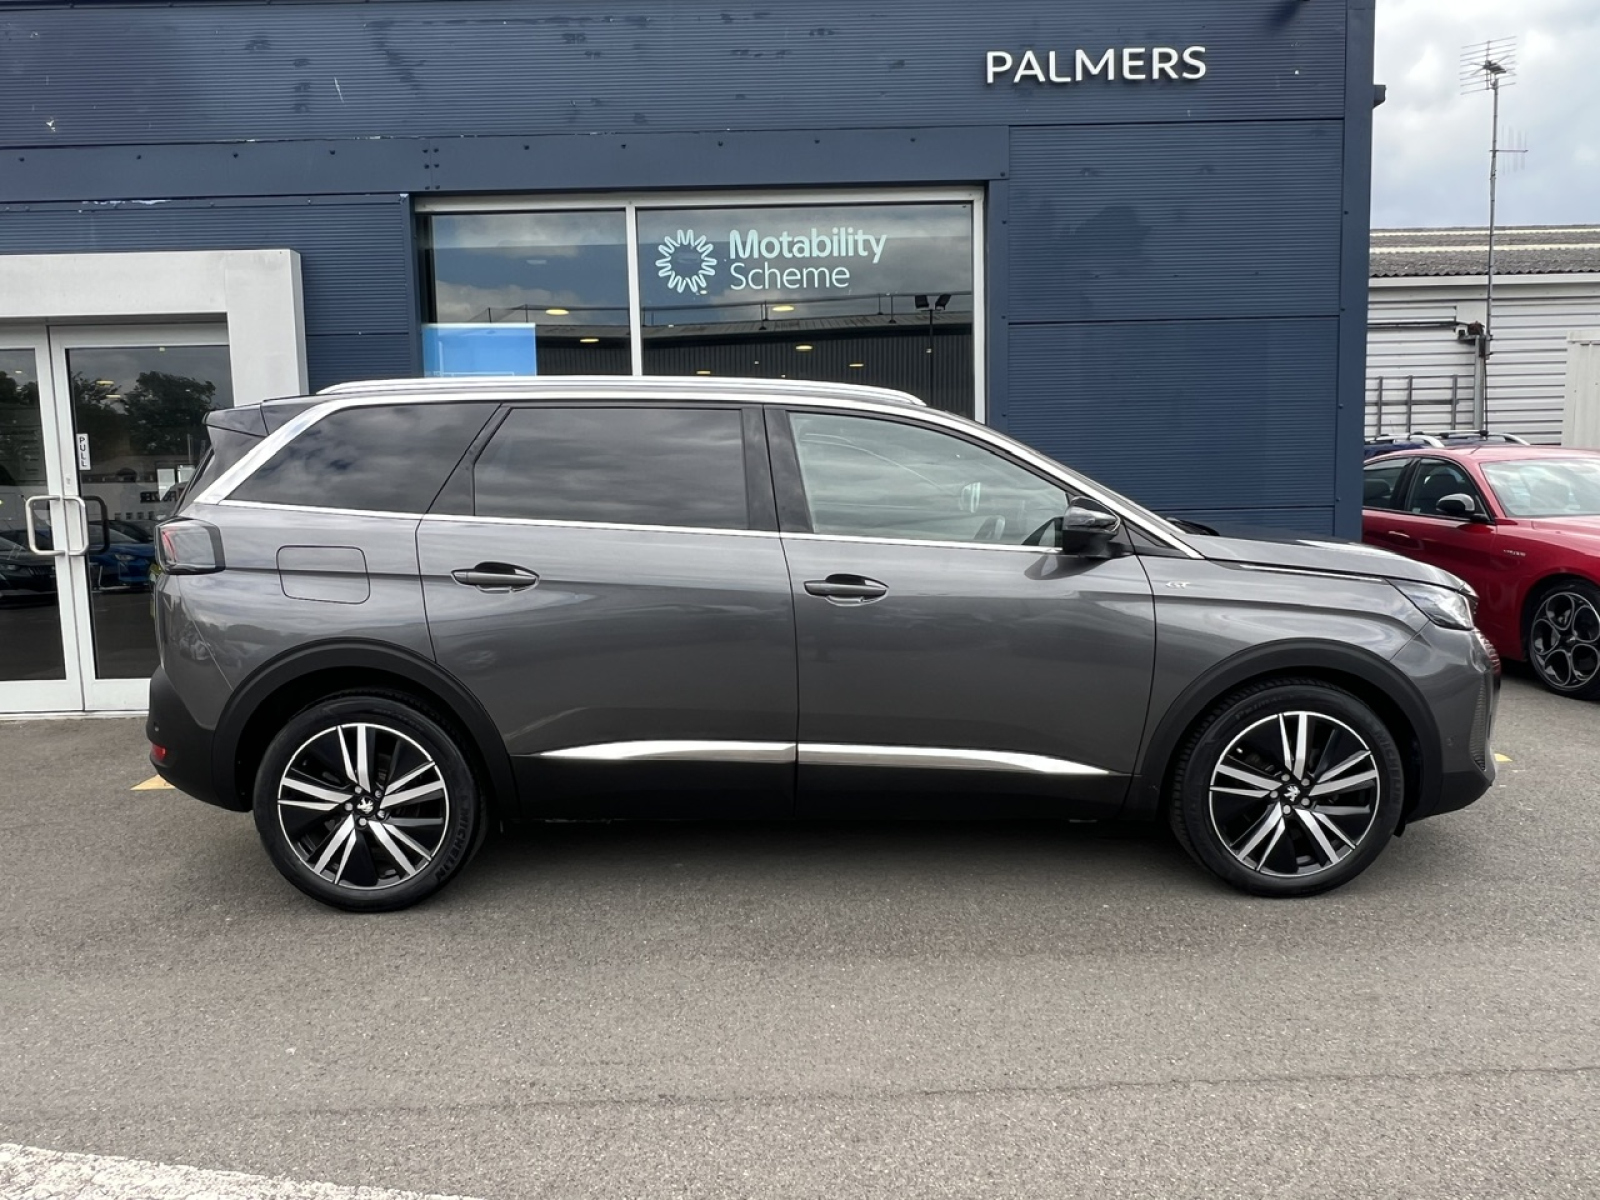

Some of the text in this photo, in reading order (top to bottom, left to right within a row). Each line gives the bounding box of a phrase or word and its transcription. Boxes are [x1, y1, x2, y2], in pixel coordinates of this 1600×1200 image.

[986, 45, 1207, 84] PALMERS
[729, 227, 887, 264] Motability
[730, 261, 850, 290] Scheme
[79, 436, 88, 467] PULL
[433, 806, 470, 881] MICHELIN
